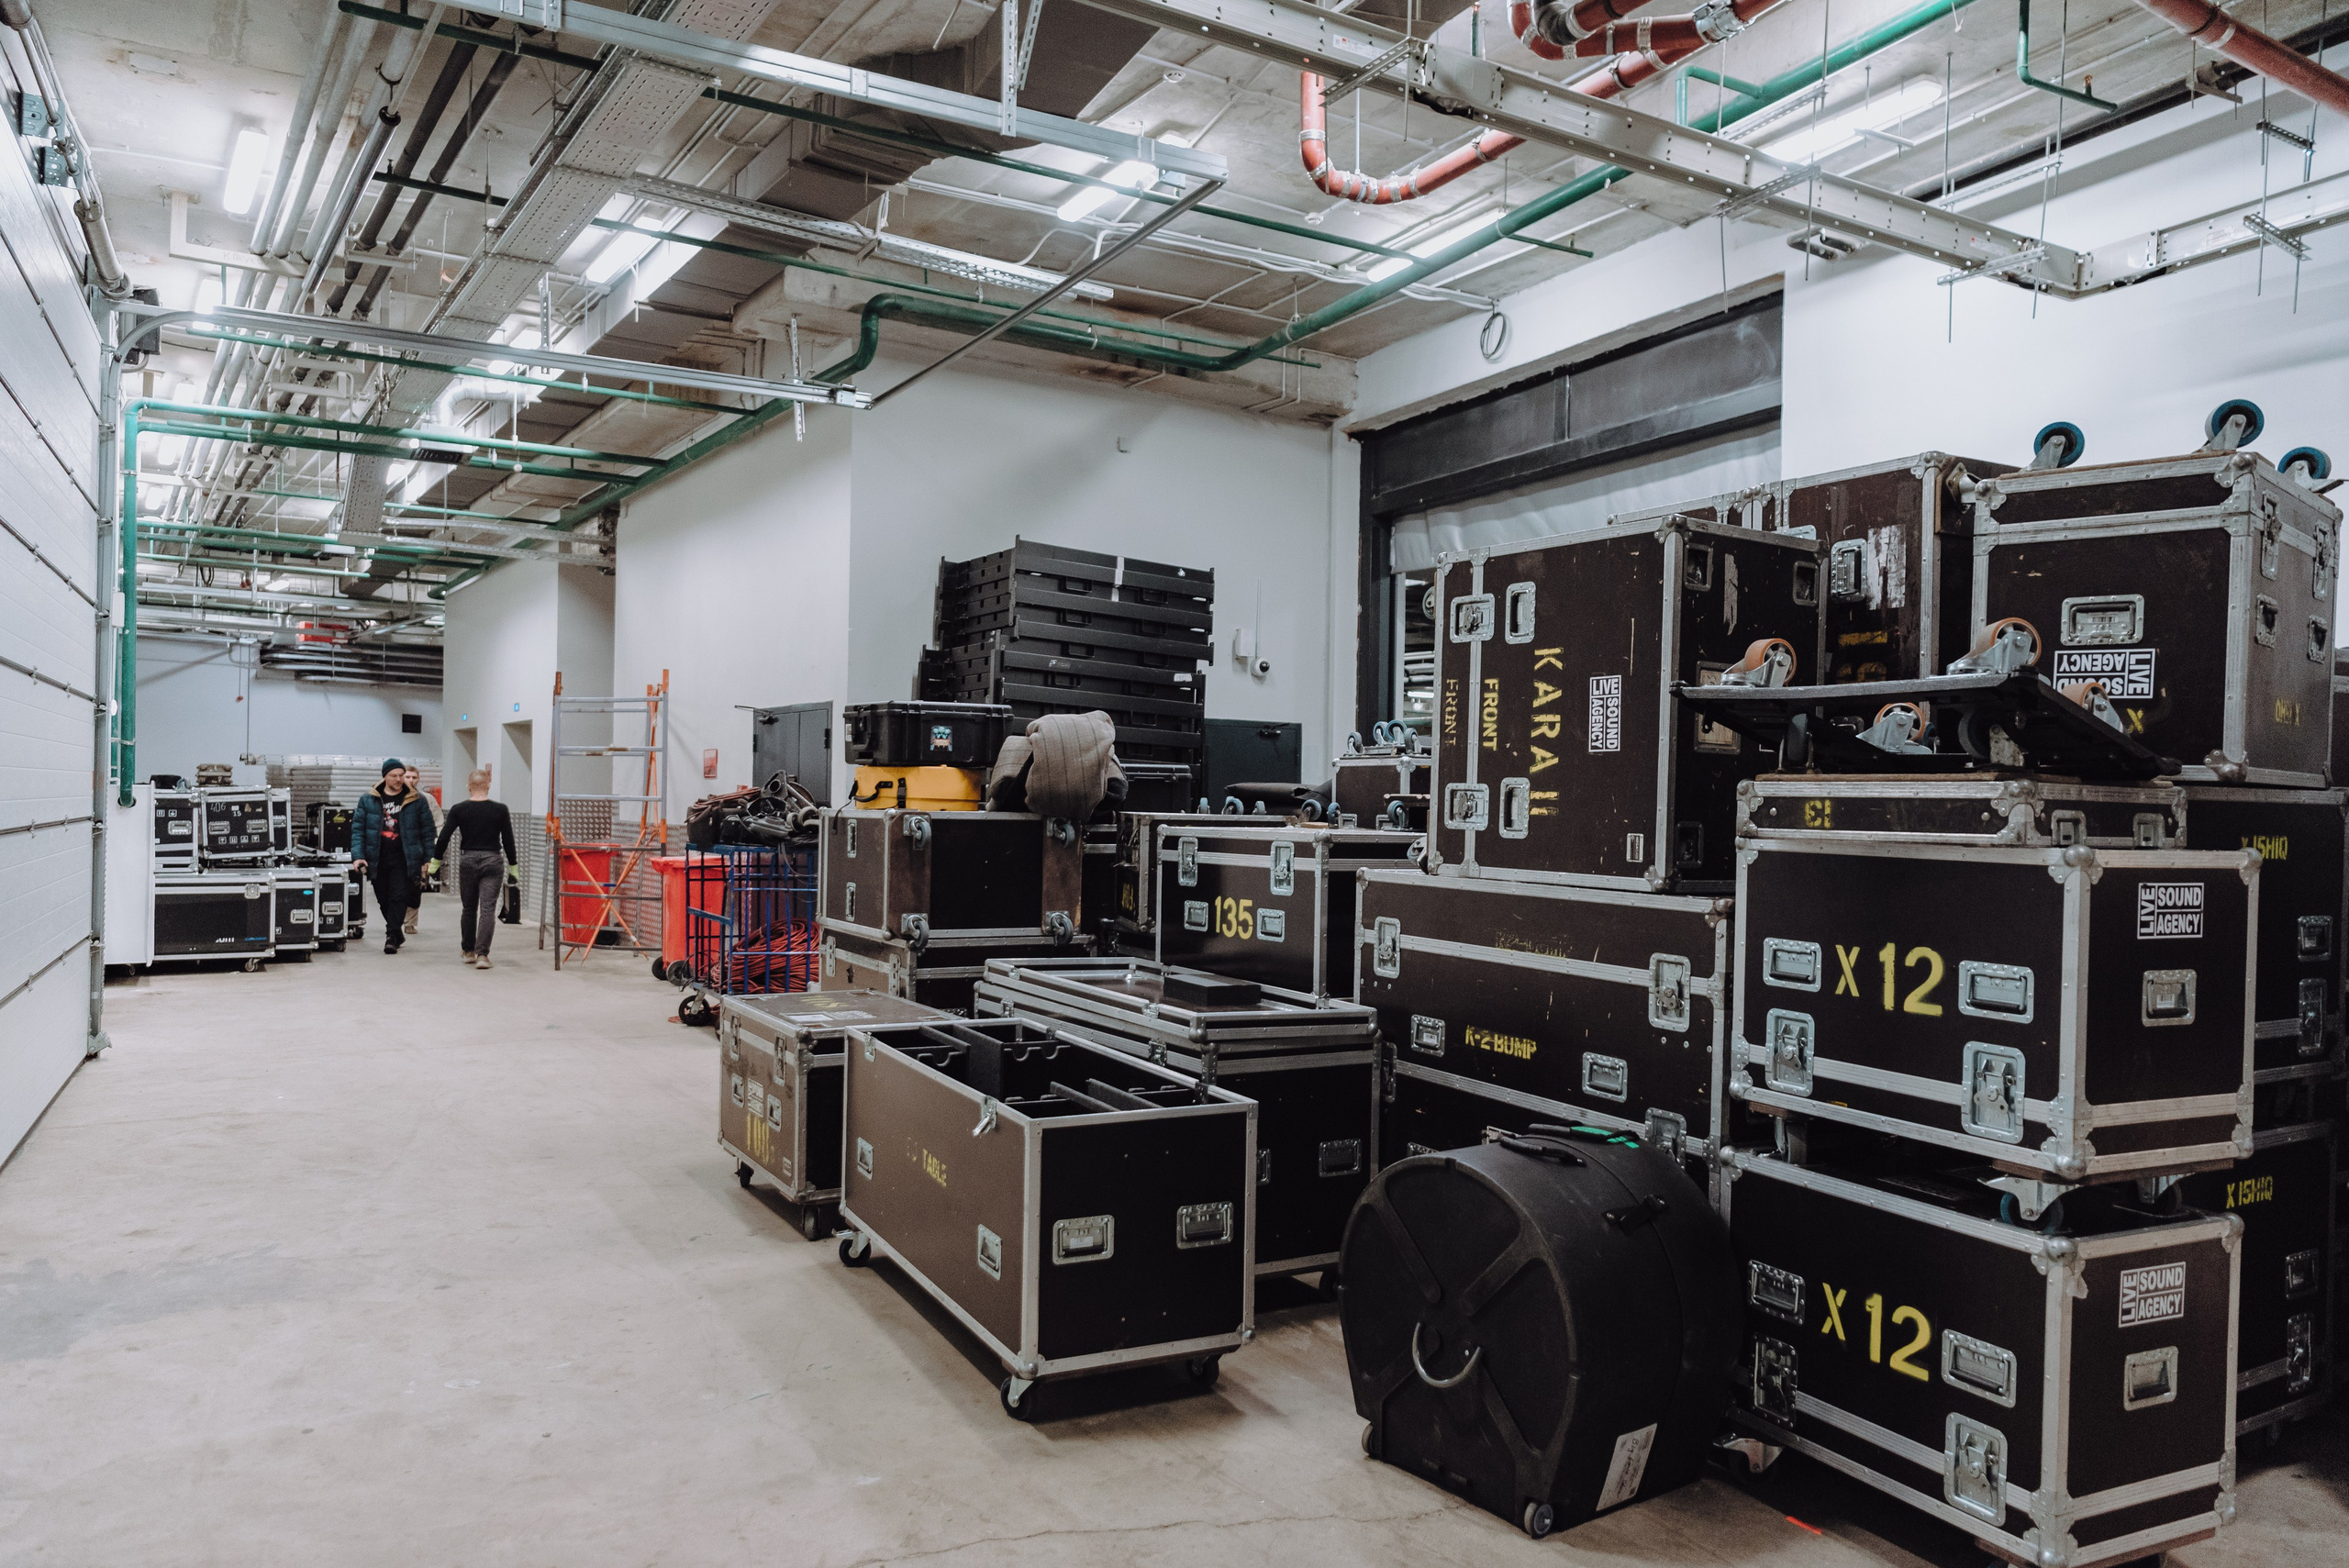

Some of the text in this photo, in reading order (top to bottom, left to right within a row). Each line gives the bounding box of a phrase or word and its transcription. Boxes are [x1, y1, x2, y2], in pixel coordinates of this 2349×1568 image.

[2058, 653, 2126, 673] AGENCY
[2128, 653, 2151, 695] LIVE
[1592, 678, 1619, 695] LIVE
[2056, 677, 2124, 695] SOD
[1482, 677, 1499, 751] FRONT
[1529, 647, 1564, 774] KARA
[1591, 698, 1604, 749] AGENCY
[1606, 697, 1619, 750] SOUND
[1215, 895, 1253, 940] 135
[2140, 887, 2155, 933] LIVE
[2157, 886, 2202, 906] SOUND
[2156, 914, 2200, 934] AGENCY
[1835, 941, 1944, 1017] X 12
[2226, 1183, 2235, 1208] X
[2121, 1273, 2137, 1321] LIVE
[2139, 1266, 2183, 1292] SOUND
[2138, 1294, 2181, 1319] AGENCY
[1821, 1282, 1932, 1382] X 12
